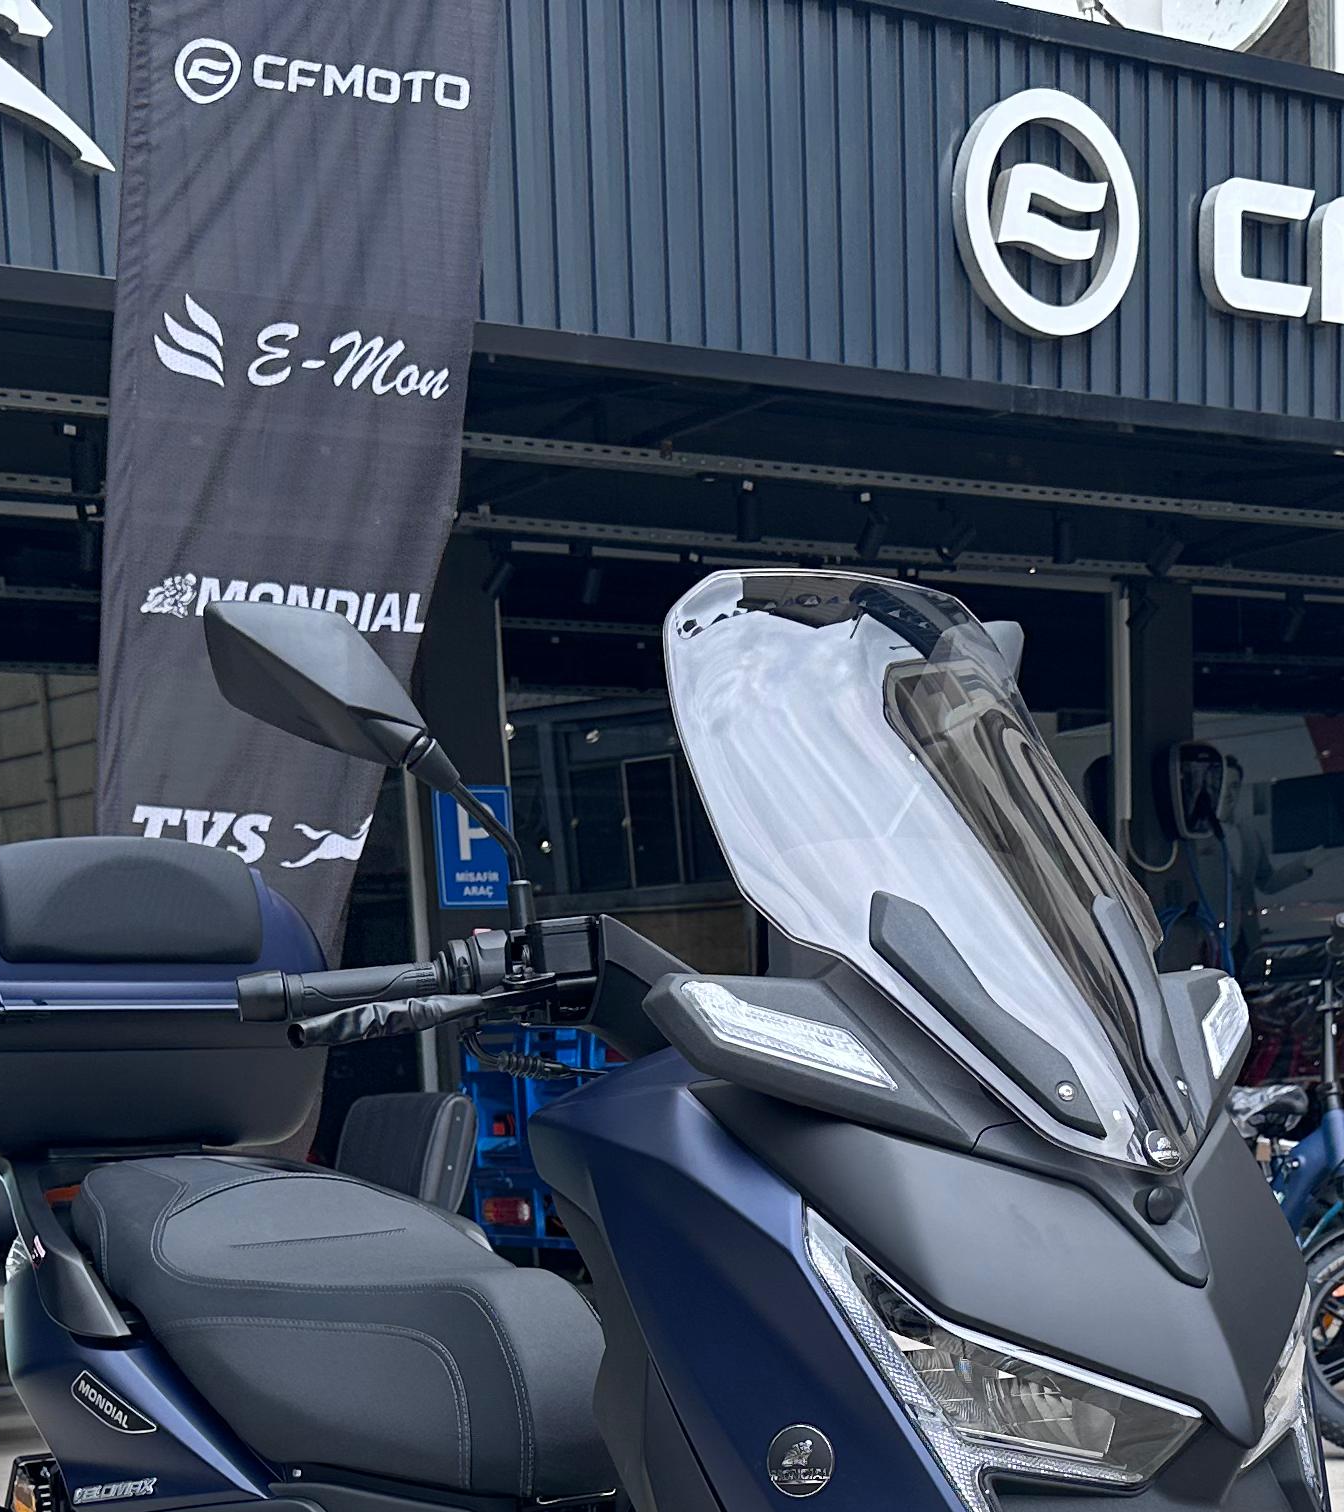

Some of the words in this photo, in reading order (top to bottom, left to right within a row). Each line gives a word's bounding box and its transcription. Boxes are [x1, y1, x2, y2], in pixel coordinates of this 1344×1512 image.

[253, 53, 471, 110] CFMOTO
[247, 322, 449, 399] E-Mon
[132, 804, 272, 865] TVS
[457, 800, 497, 862] P
[455, 870, 500, 882] MİSAFİR
[462, 886, 494, 899] ARAÇ
[78, 1379, 129, 1429] MONDIAL
